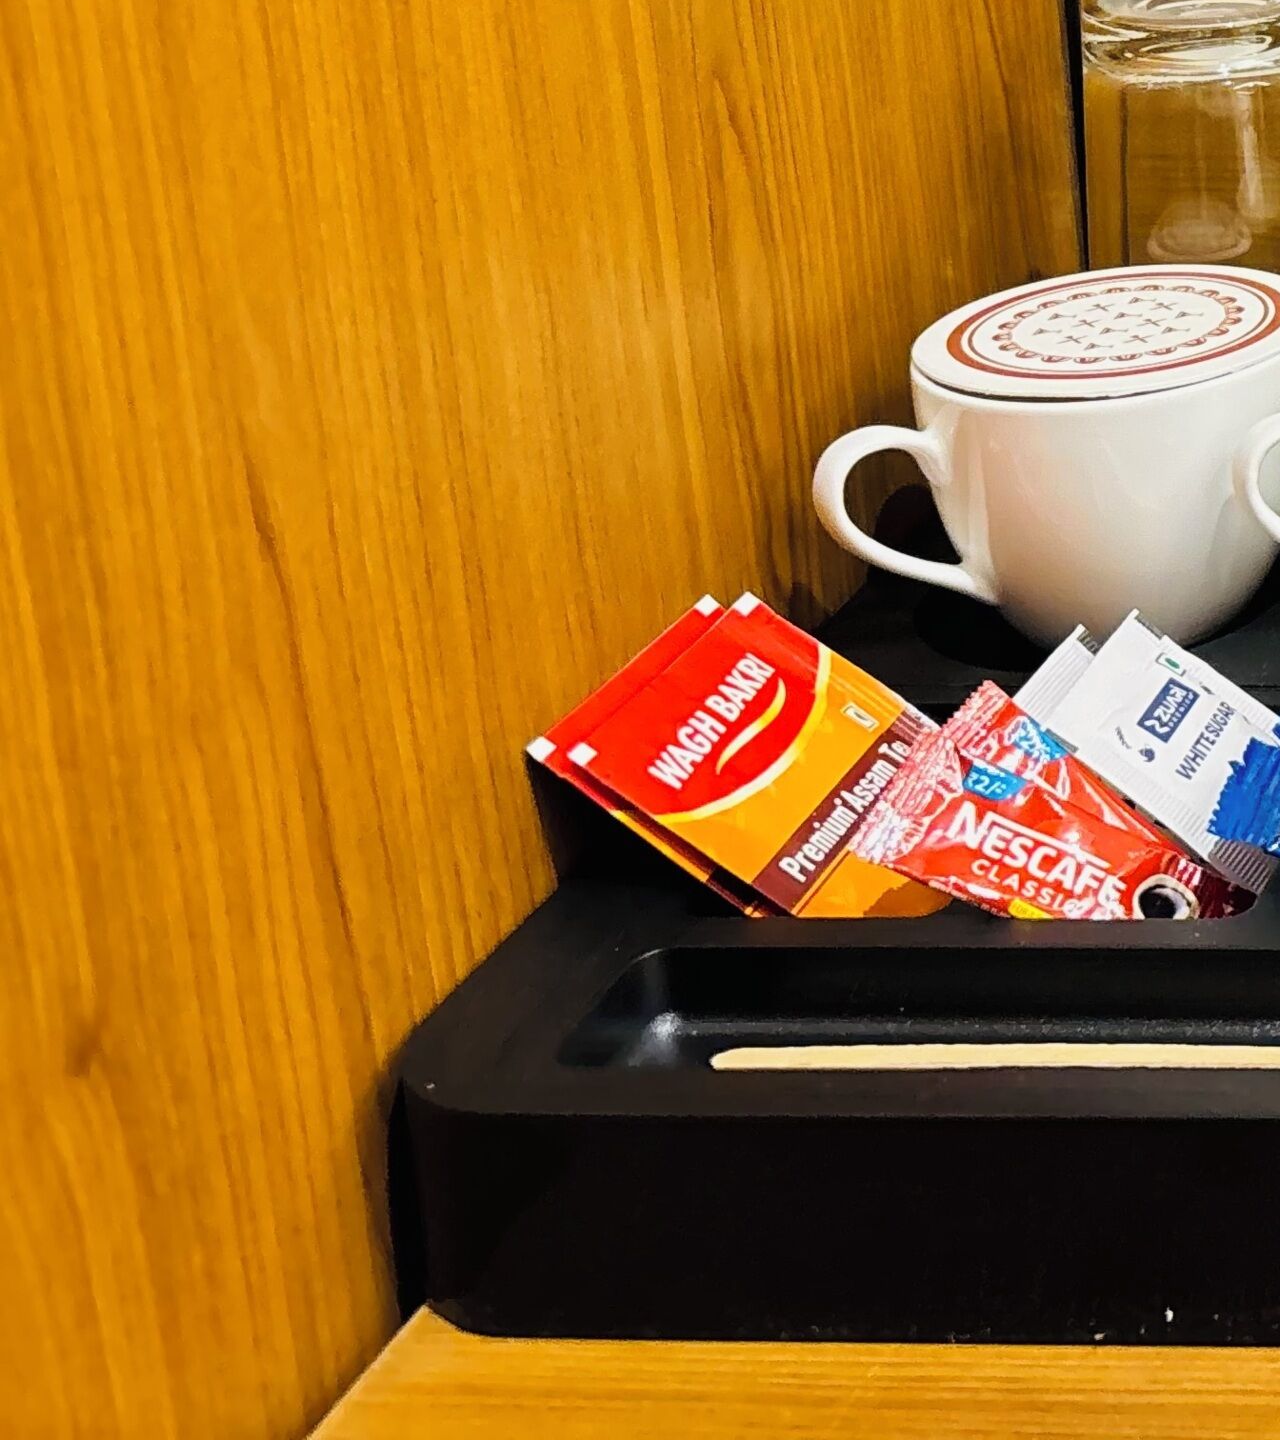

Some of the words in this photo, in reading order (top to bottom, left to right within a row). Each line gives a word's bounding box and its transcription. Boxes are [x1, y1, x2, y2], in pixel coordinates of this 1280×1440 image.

[648, 708, 728, 790] WAGH
[705, 653, 776, 723] BAKRI
[1175, 732, 1216, 780] WHITE
[1204, 701, 1237, 738] SUGAR
[778, 802, 857, 883] Premium
[843, 759, 898, 815] Assam
